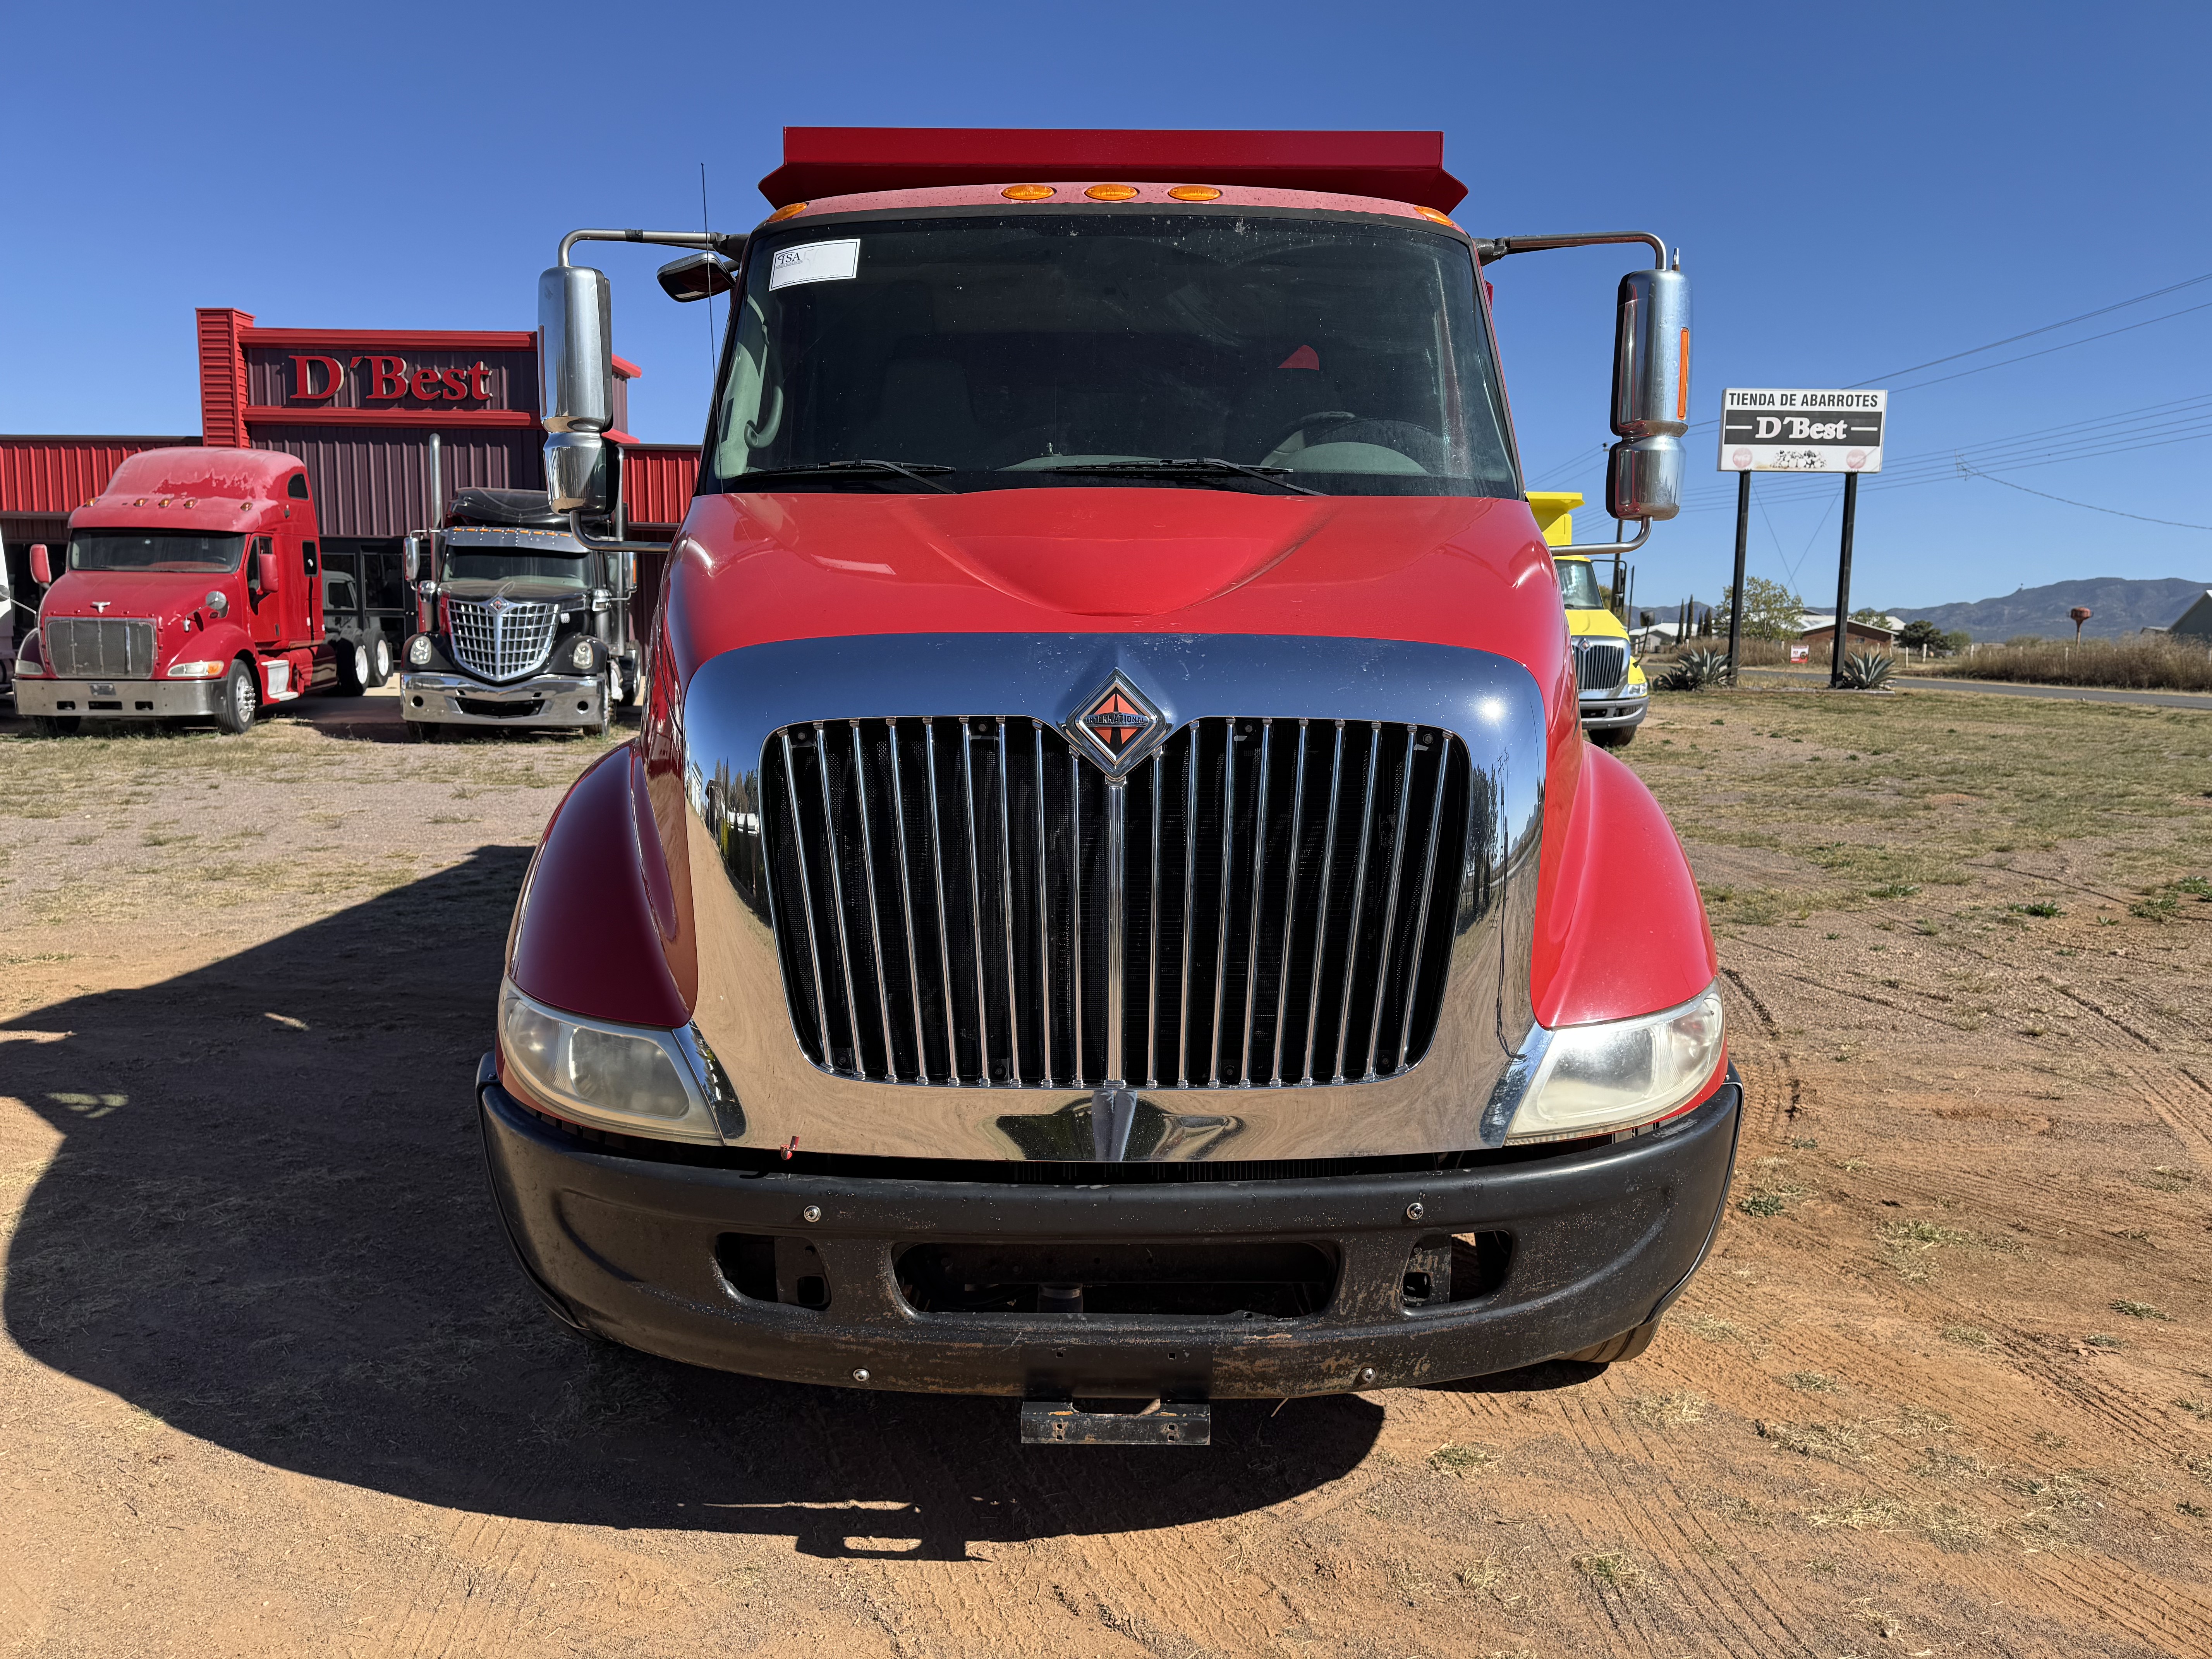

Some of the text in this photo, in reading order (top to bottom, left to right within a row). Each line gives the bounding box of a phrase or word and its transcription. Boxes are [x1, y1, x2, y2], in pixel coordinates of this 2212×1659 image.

[1729, 393, 1878, 407] TIENDA DE ABARROTES
[1086, 713, 1145, 724] INTERNATIONAL
